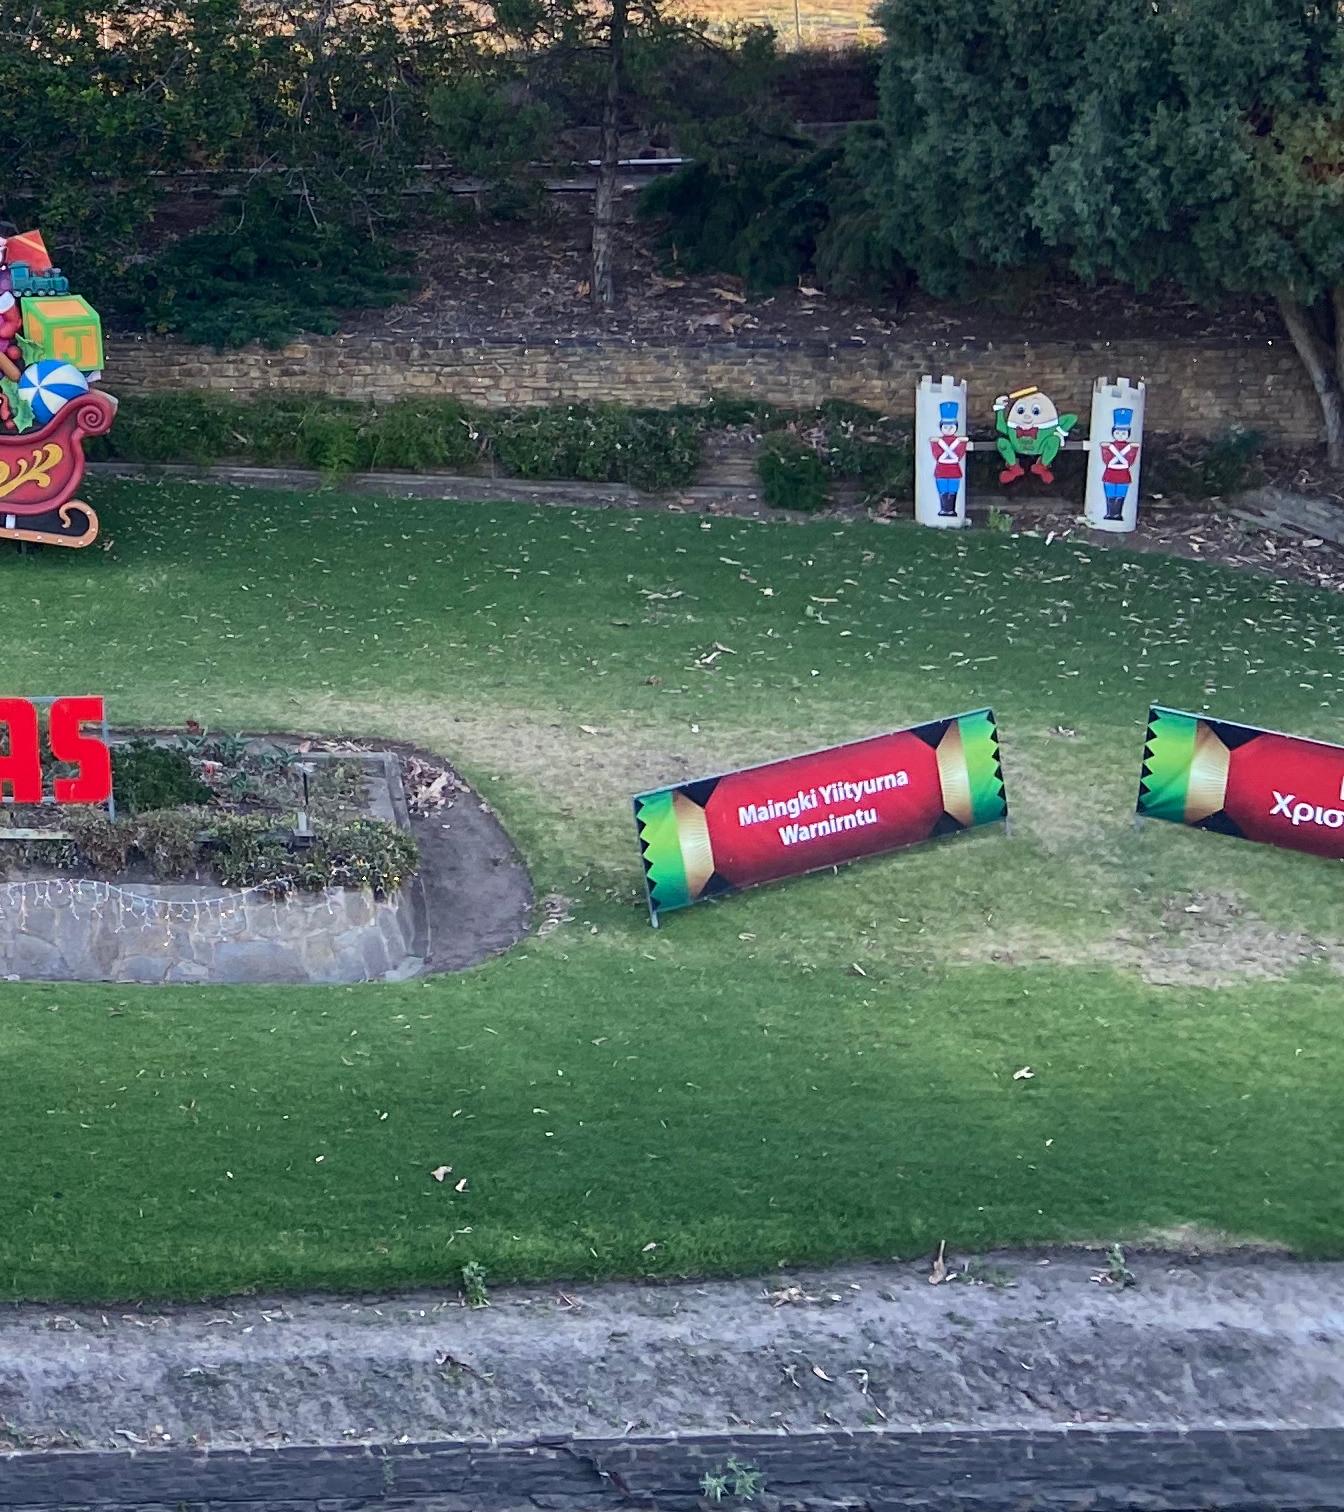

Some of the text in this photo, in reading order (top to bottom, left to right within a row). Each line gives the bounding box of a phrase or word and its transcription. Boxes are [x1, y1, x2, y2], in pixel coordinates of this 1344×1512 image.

[737, 770, 909, 826] Maingki Yiityurna
[778, 807, 878, 846] Warnirntu
